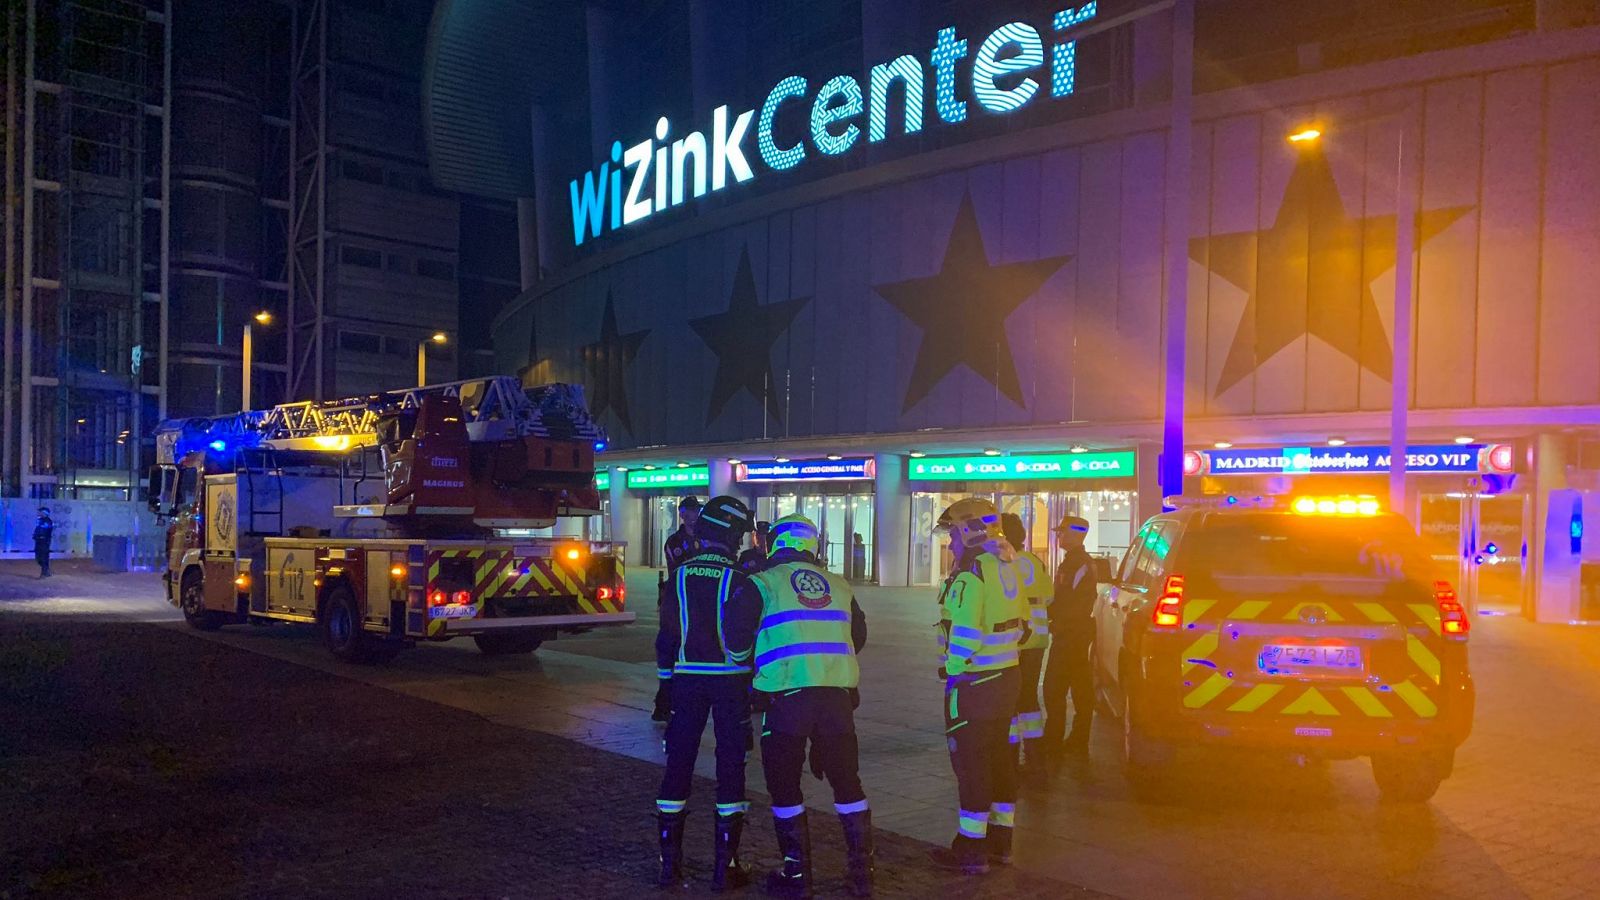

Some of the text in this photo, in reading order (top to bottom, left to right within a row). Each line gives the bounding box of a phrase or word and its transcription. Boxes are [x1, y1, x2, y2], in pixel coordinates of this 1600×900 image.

[1216, 456, 1291, 469] MADRID
[1441, 454, 1471, 466] VIP
[422, 479, 465, 488] MAGIRUS
[685, 566, 722, 578] MADRID
[1372, 554, 1405, 579] 112
[288, 567, 305, 600] 112
